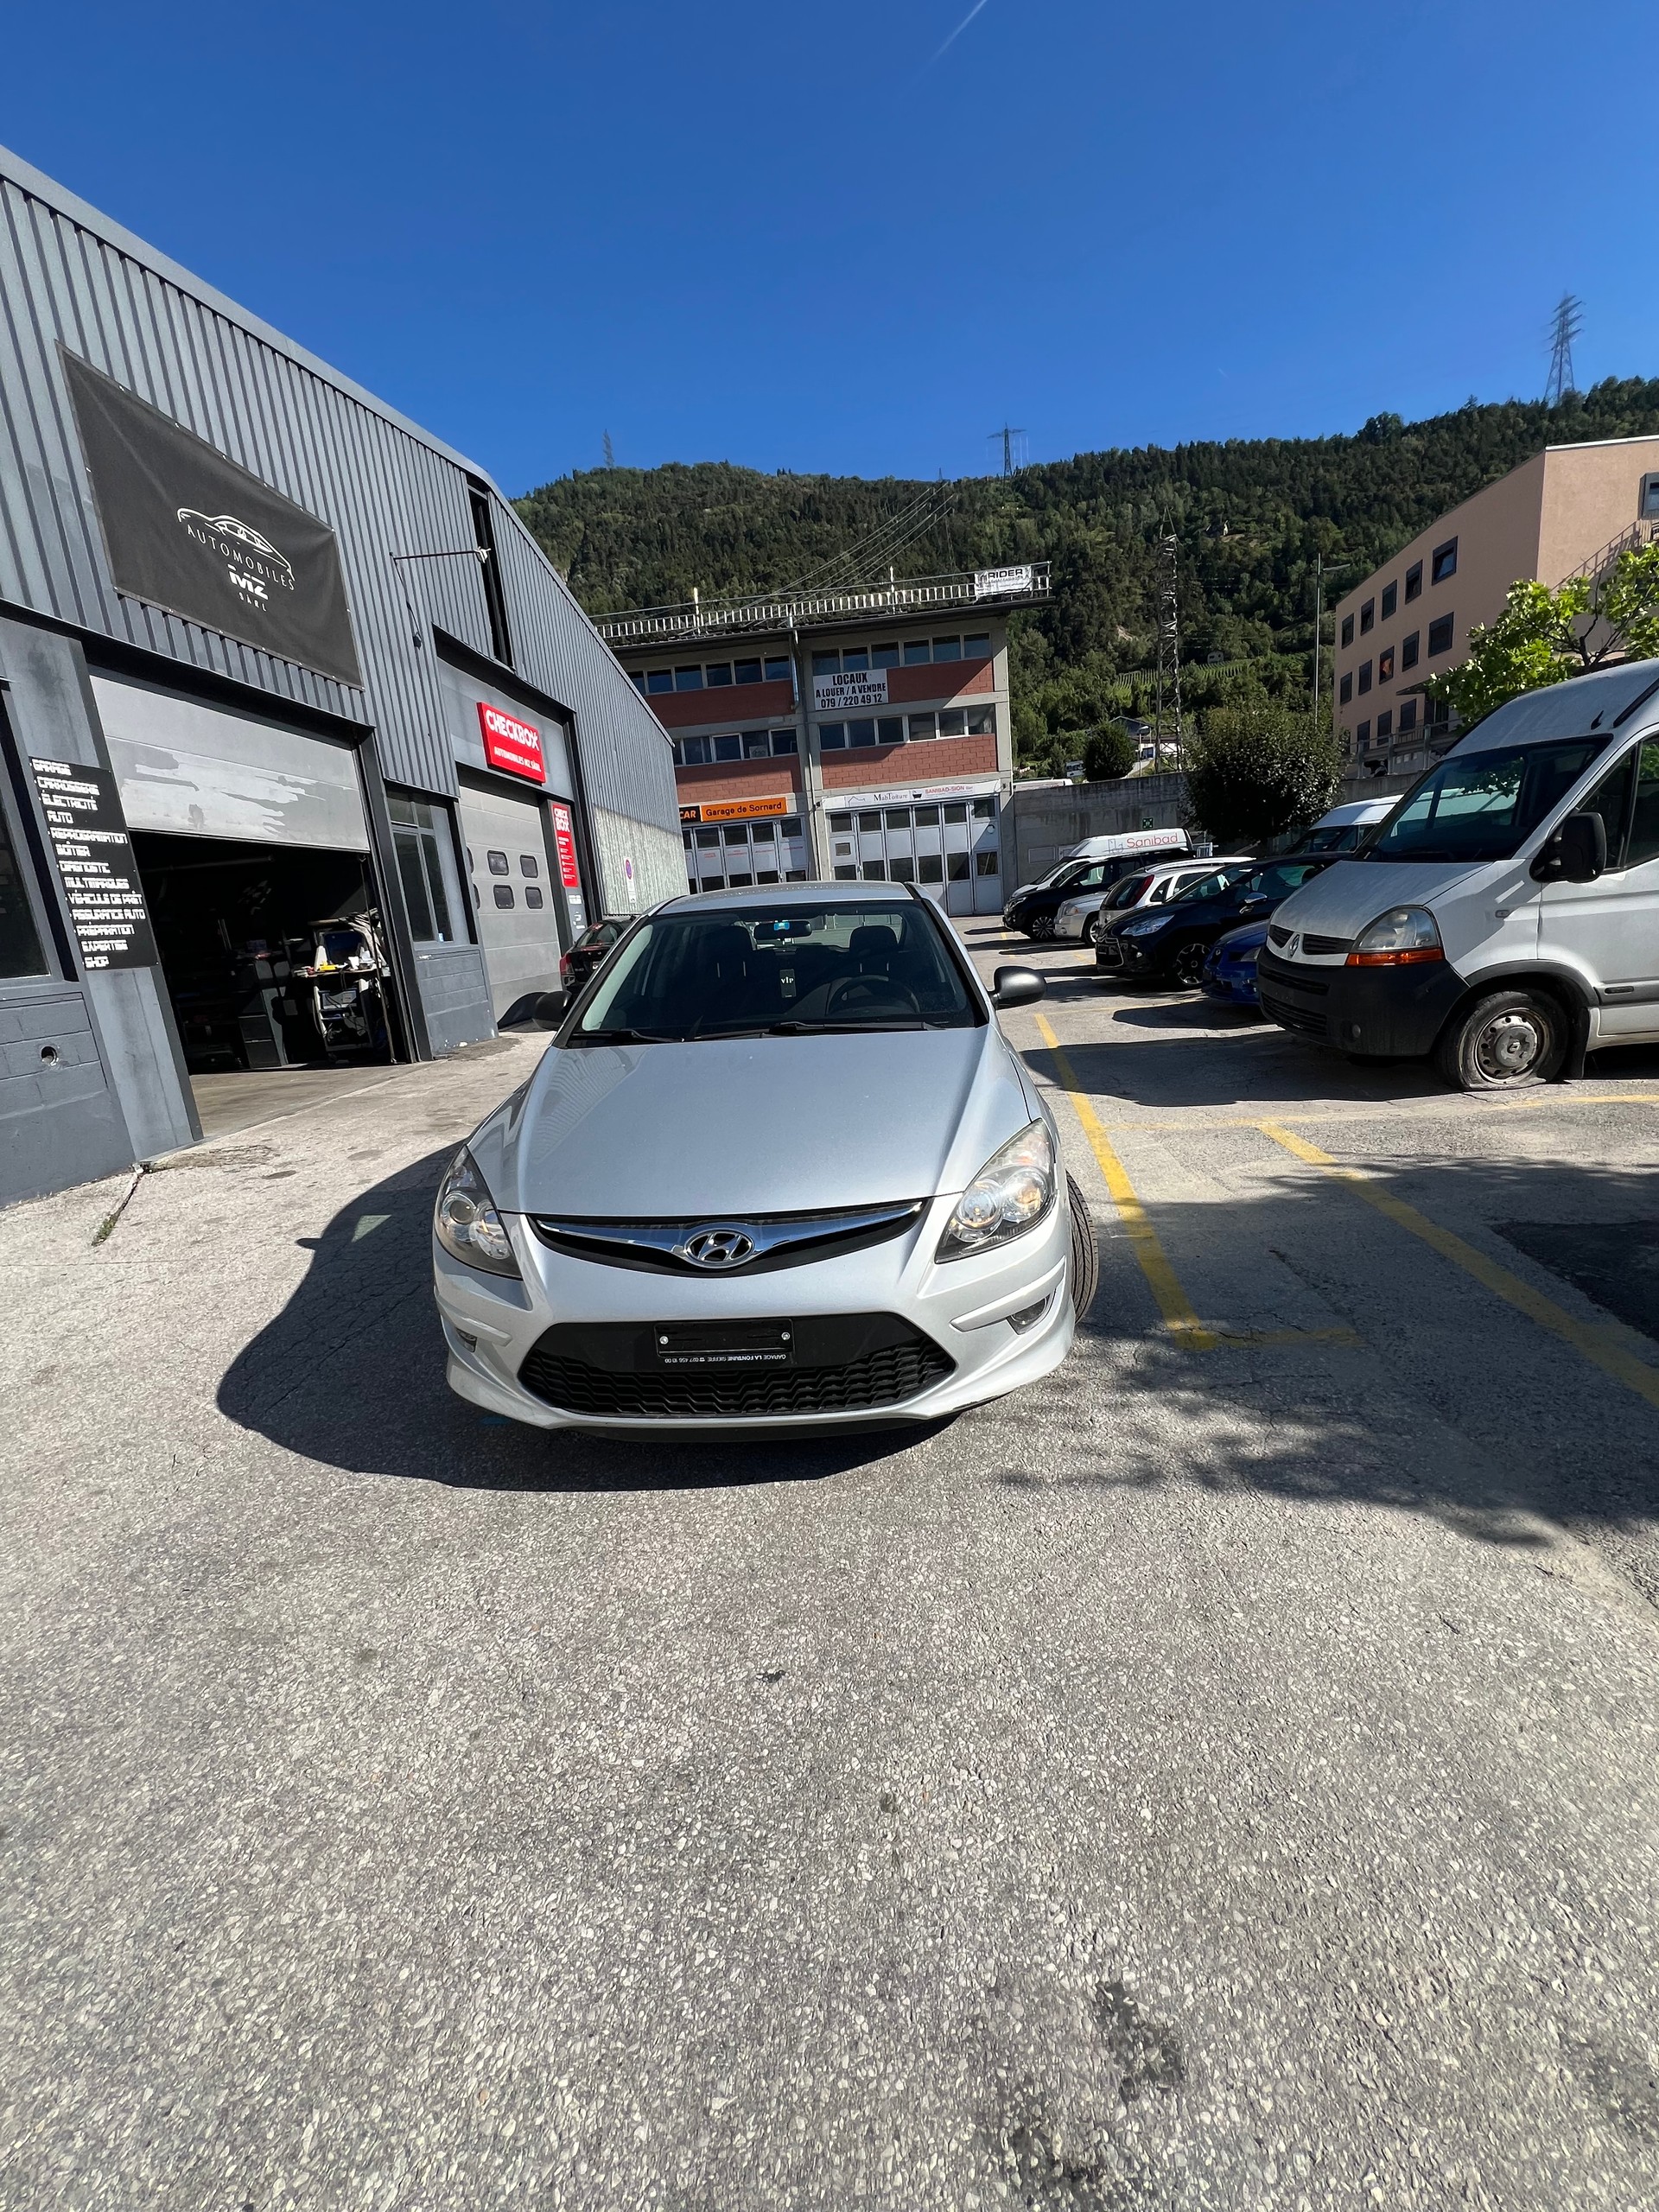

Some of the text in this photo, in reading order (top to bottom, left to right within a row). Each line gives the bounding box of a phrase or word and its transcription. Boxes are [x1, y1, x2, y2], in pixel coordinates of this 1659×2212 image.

[188, 524, 295, 590] AUTOMOBILES
[227, 563, 269, 601] MZ
[832, 672, 868, 686] LOCAUX
[816, 689, 822, 698] A
[822, 687, 845, 697] LOUER
[851, 685, 857, 695] A
[857, 683, 887, 694] VENDRE
[820, 697, 836, 708] 079
[843, 696, 859, 706] 220
[861, 694, 871, 704] 49
[873, 693, 882, 703] 12
[486, 709, 540, 752] CHECKBOX
[32, 759, 72, 776] GARAGE
[46, 810, 74, 824] AUTO
[706, 807, 735, 817] Garage
[748, 802, 782, 812] Sornard
[1126, 833, 1179, 849] Sanibad
[58, 860, 111, 874] DIAGNOSTIC
[64, 876, 130, 889] MULTIMARQUES
[110, 893, 123, 905] DE
[72, 908, 146, 920] ASSURANCE AUTO
[84, 956, 110, 968] SHOP
